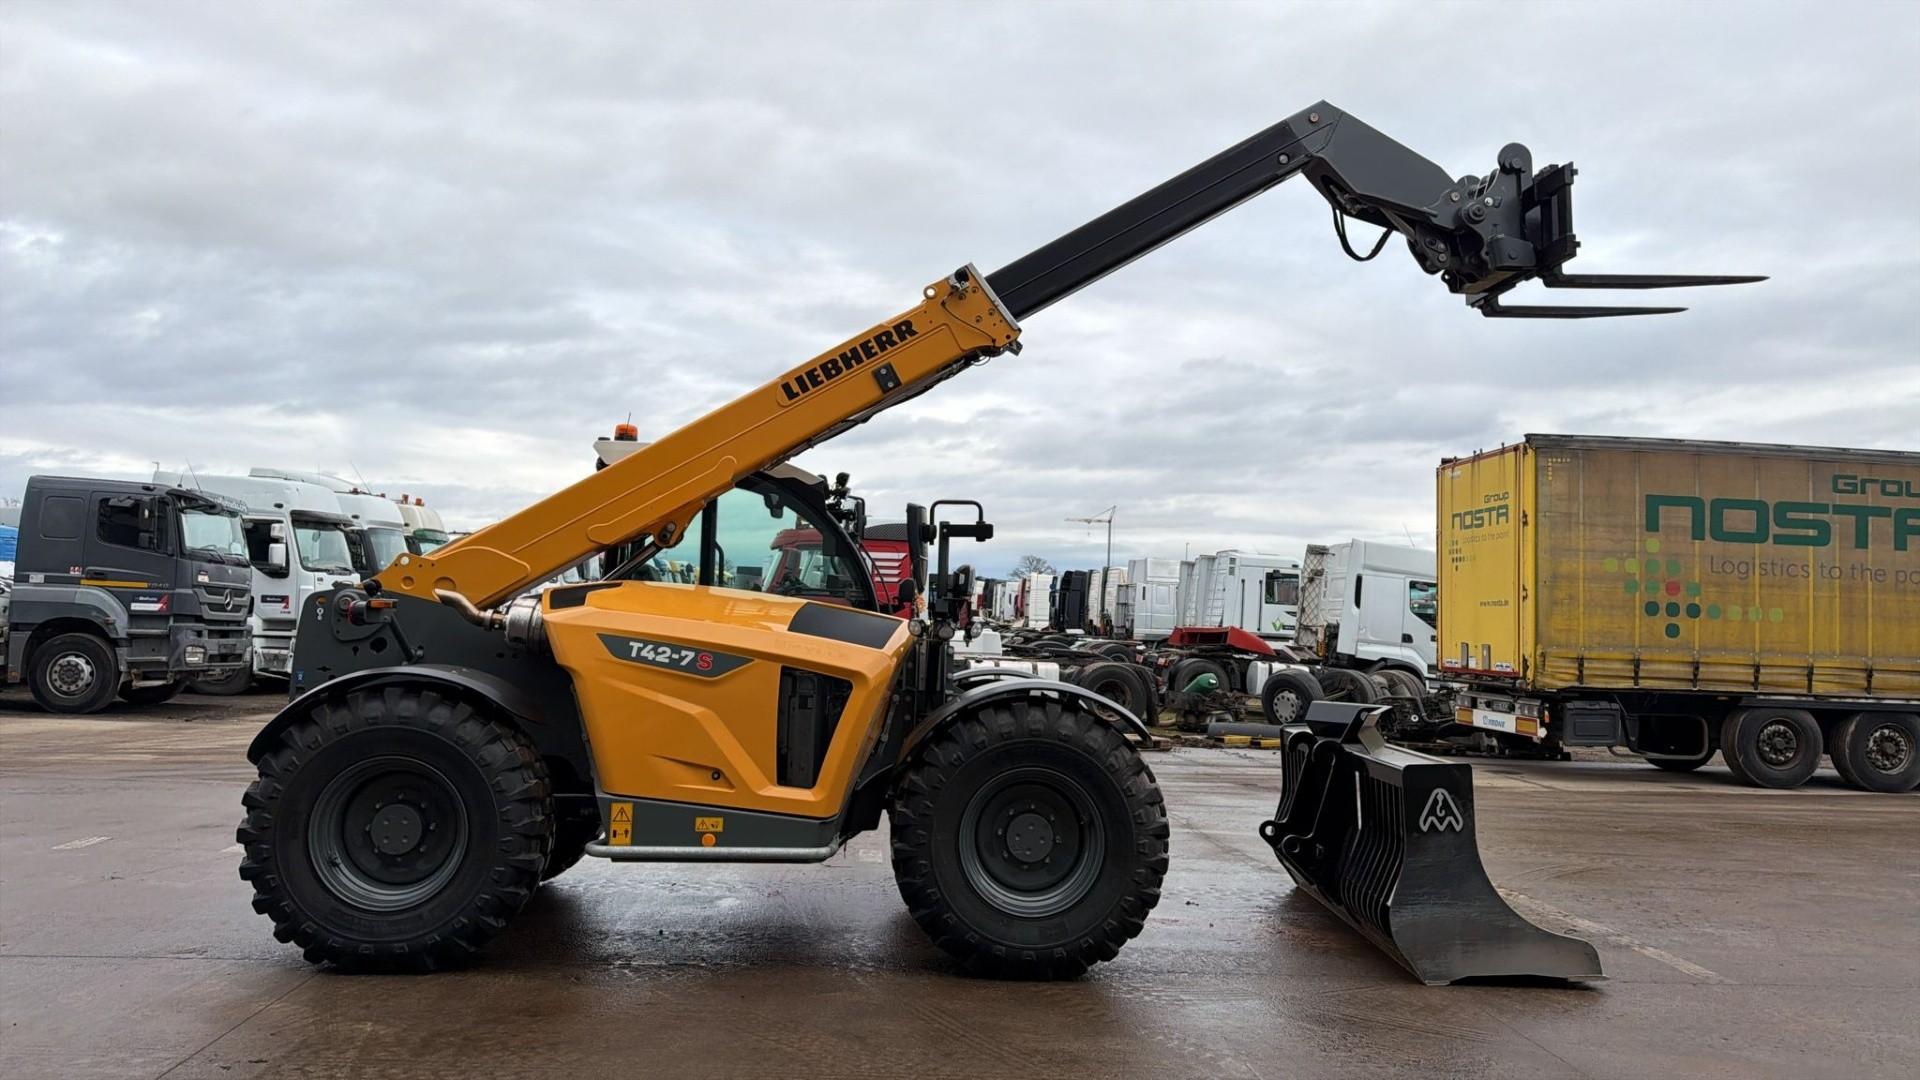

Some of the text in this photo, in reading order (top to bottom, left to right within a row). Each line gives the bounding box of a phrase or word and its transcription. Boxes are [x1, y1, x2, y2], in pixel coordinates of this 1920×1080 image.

[781, 319, 919, 401] LIEBHERR
[1483, 491, 1509, 504] Group
[1451, 504, 1509, 530] NOSTA
[1710, 555, 1810, 580] Logistics
[1820, 563, 1843, 580] to
[1850, 563, 1887, 583] the
